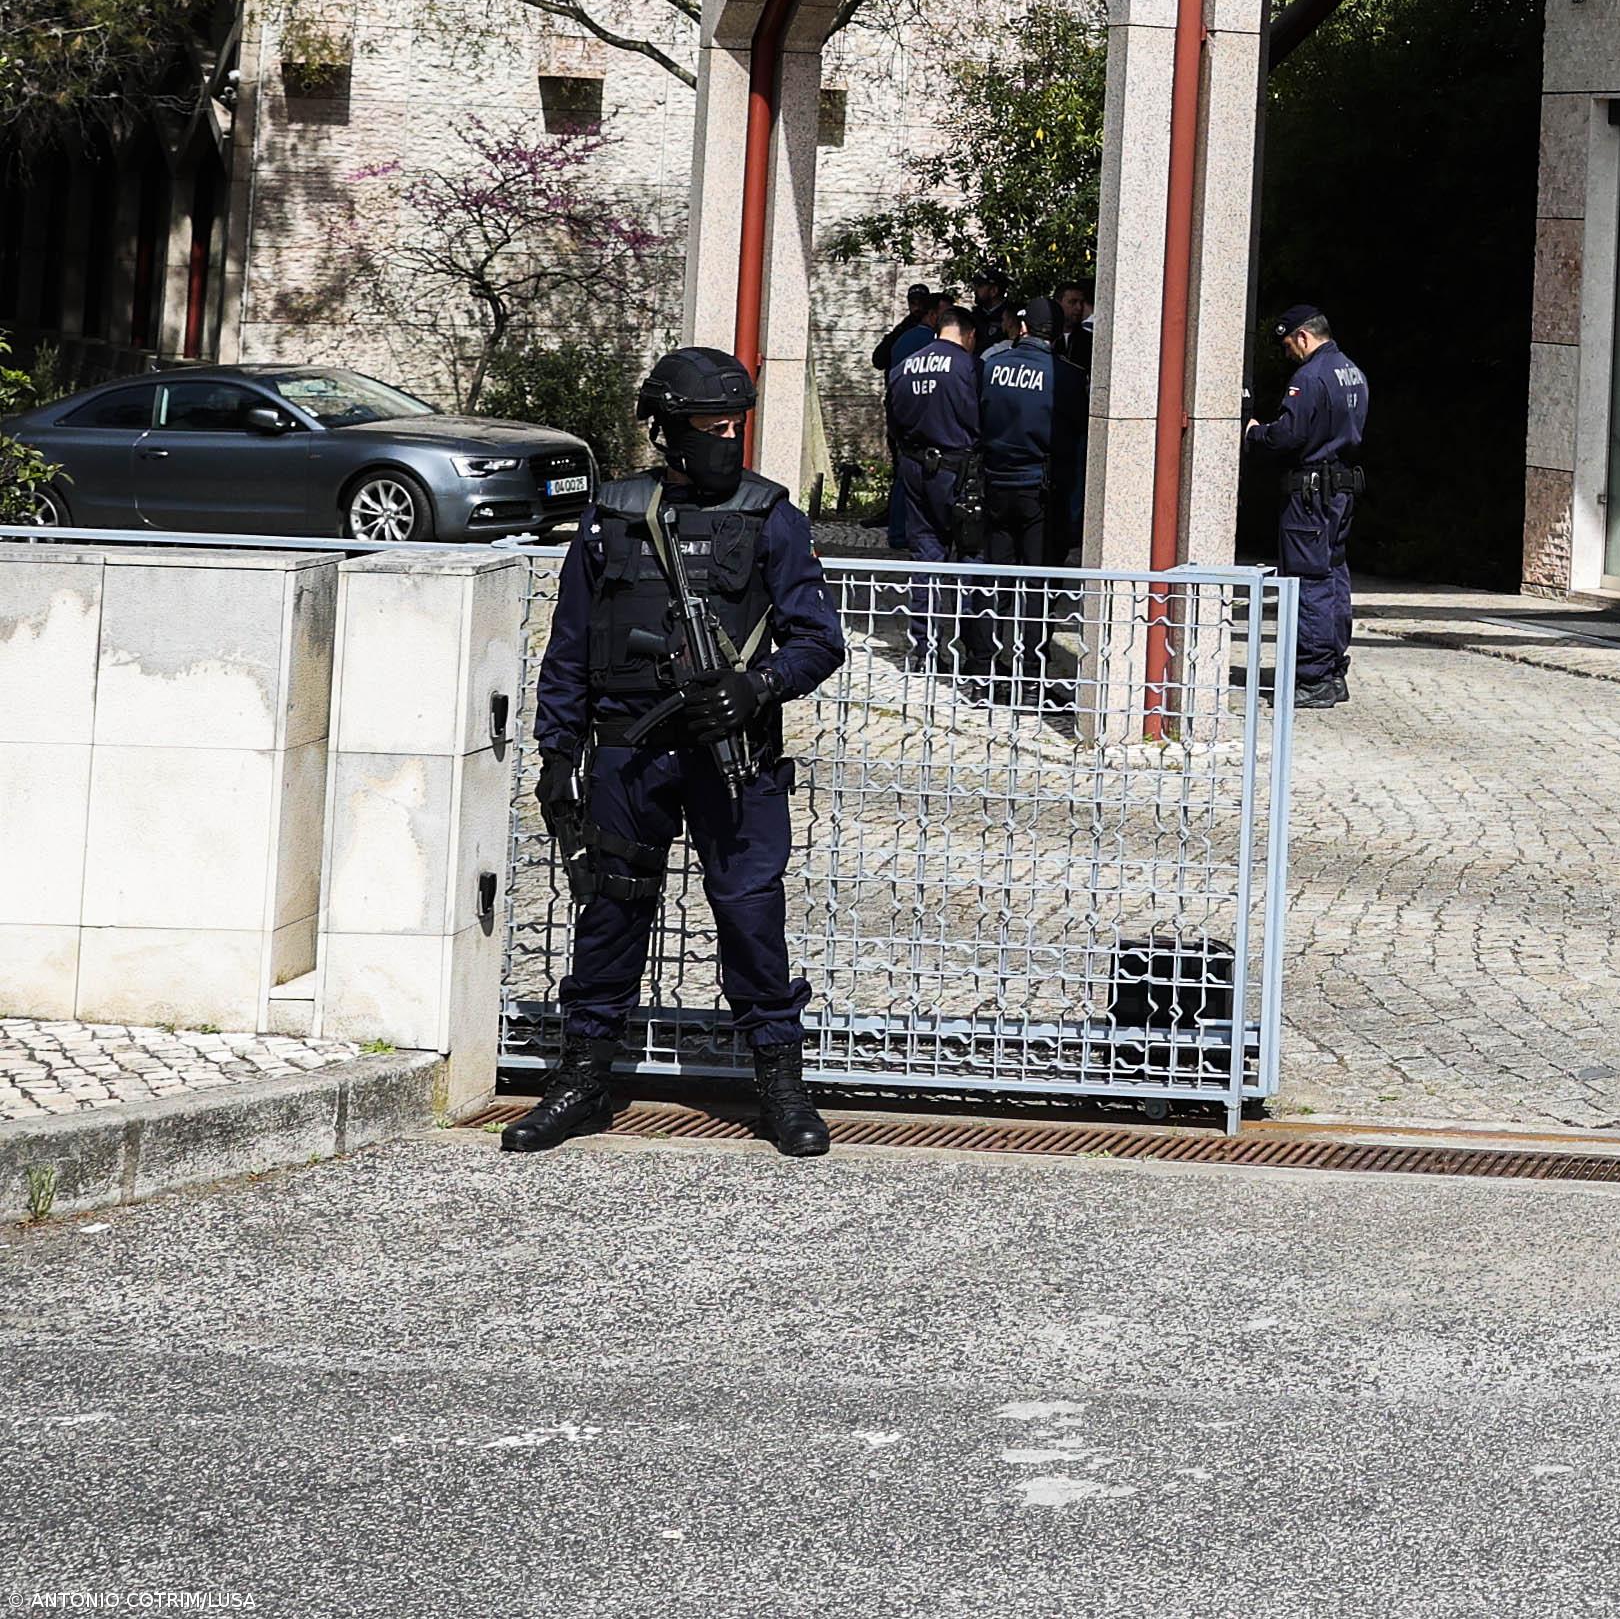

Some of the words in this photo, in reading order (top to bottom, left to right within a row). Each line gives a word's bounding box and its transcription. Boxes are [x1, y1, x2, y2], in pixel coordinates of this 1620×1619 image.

[903, 352, 952, 375] POLÍCIA
[912, 380, 937, 395] UEP
[991, 364, 1044, 391] POLÍCIA
